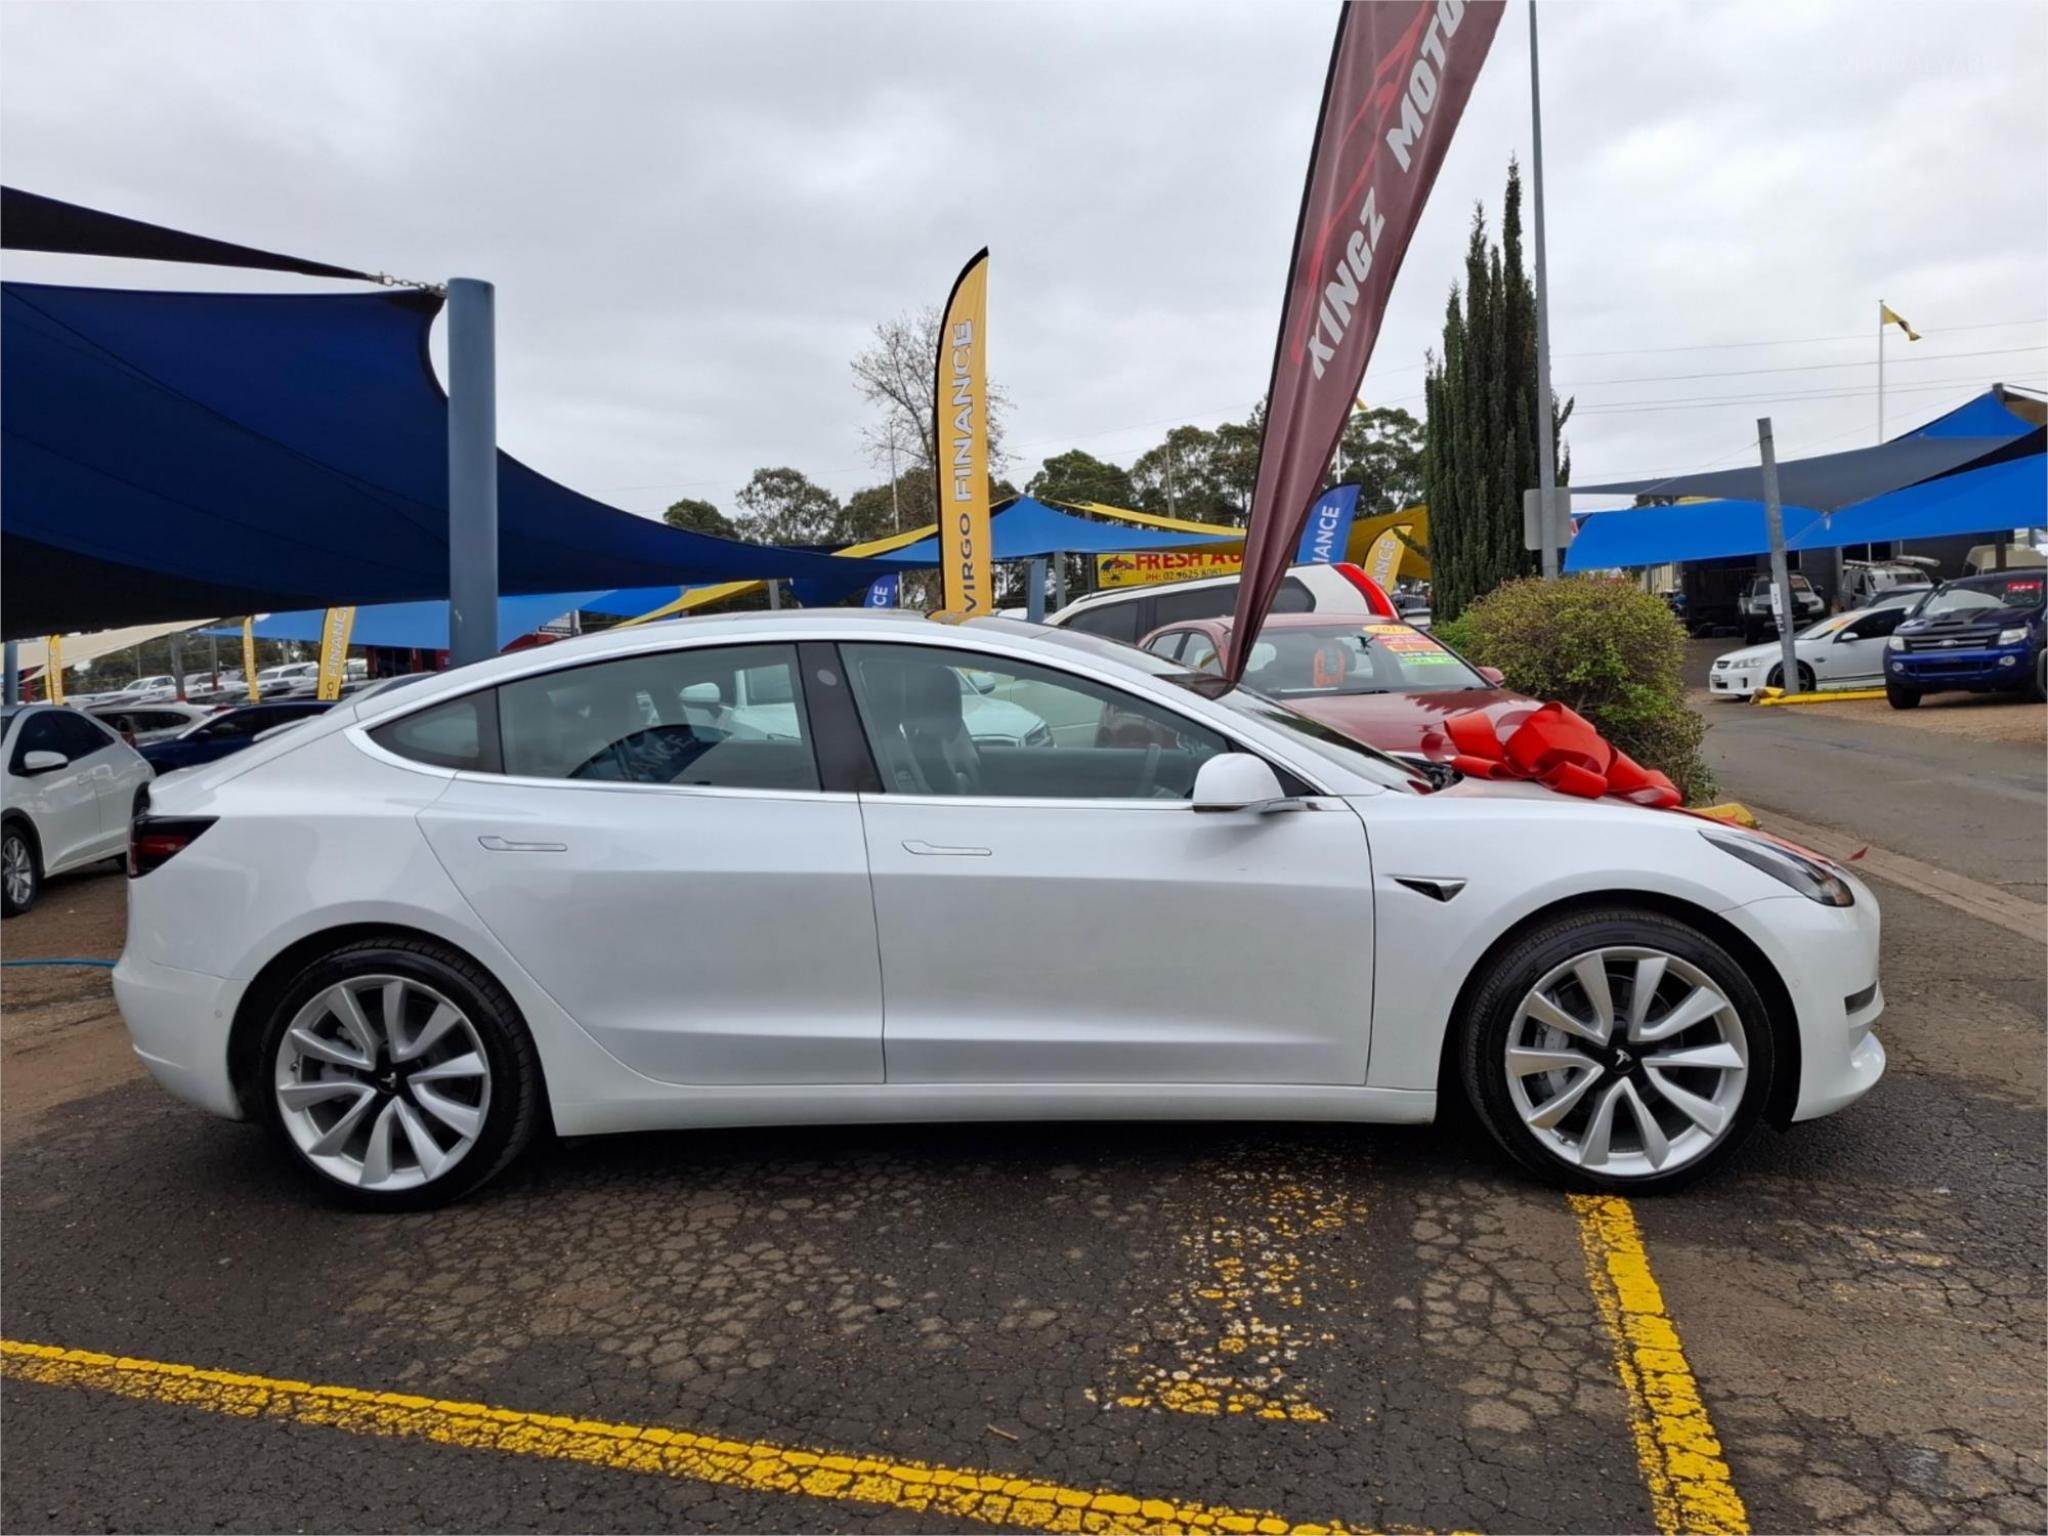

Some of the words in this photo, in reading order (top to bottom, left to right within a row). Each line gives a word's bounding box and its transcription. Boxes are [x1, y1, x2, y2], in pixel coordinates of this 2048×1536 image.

[1308, 186, 1385, 380] KINGZ
[1386, 0, 1469, 173] MOTO
[952, 318, 973, 502] FINANCE
[960, 512, 977, 613] VIRGO
[1136, 552, 1204, 571] FRESH
